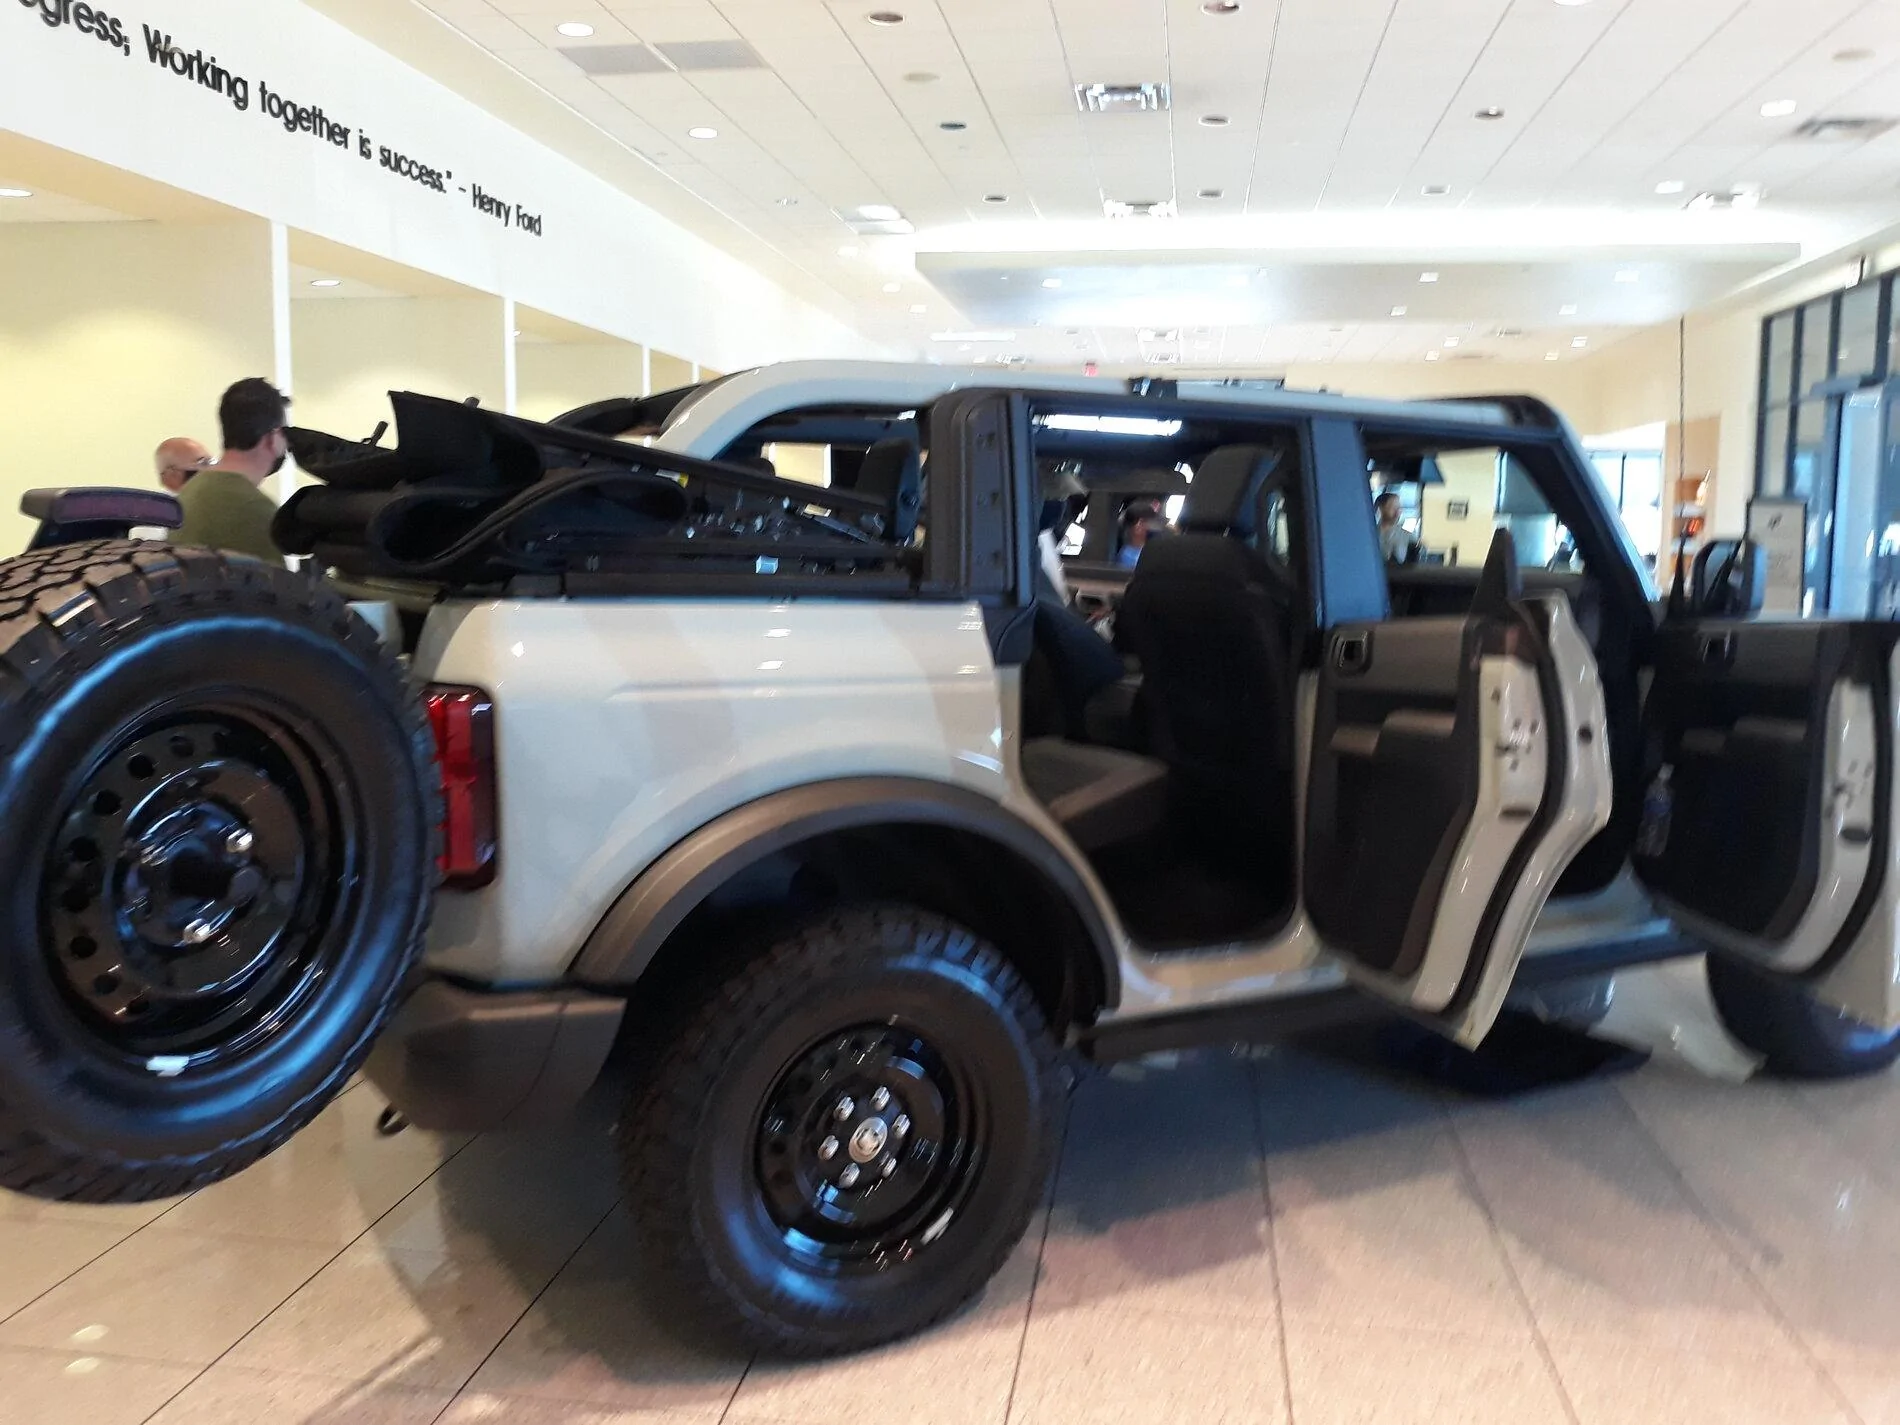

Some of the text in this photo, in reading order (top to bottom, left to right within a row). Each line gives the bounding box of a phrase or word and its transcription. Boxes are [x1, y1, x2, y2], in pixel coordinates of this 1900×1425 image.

[18, 0, 131, 57] gress;
[142, 23, 249, 111] Working
[259, 80, 351, 149] together
[358, 128, 373, 160] is
[472, 183, 511, 227] Henry
[516, 204, 542, 237] Ford
